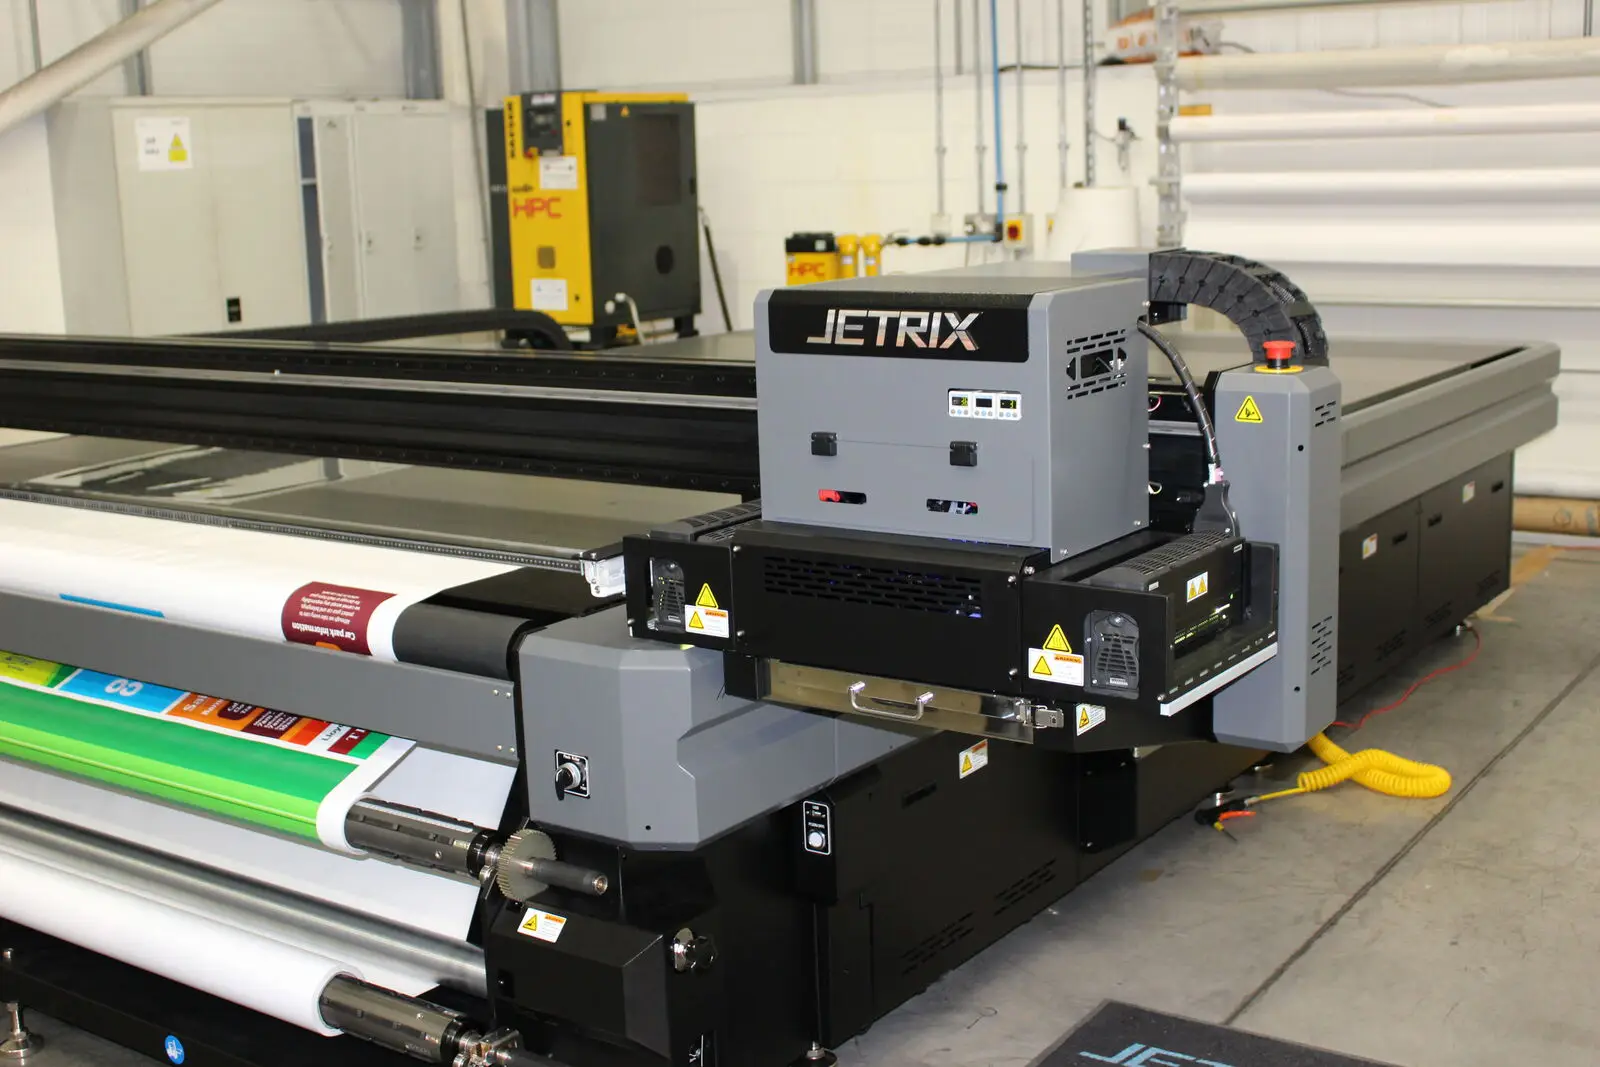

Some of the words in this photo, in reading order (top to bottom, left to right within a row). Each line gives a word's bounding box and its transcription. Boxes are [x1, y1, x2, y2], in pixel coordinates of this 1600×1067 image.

[512, 197, 563, 219] HPC
[788, 261, 826, 277] HPC
[806, 308, 980, 351] JETRIX
[291, 621, 330, 636] information
[329, 628, 345, 639] park
[345, 631, 356, 641] Car
